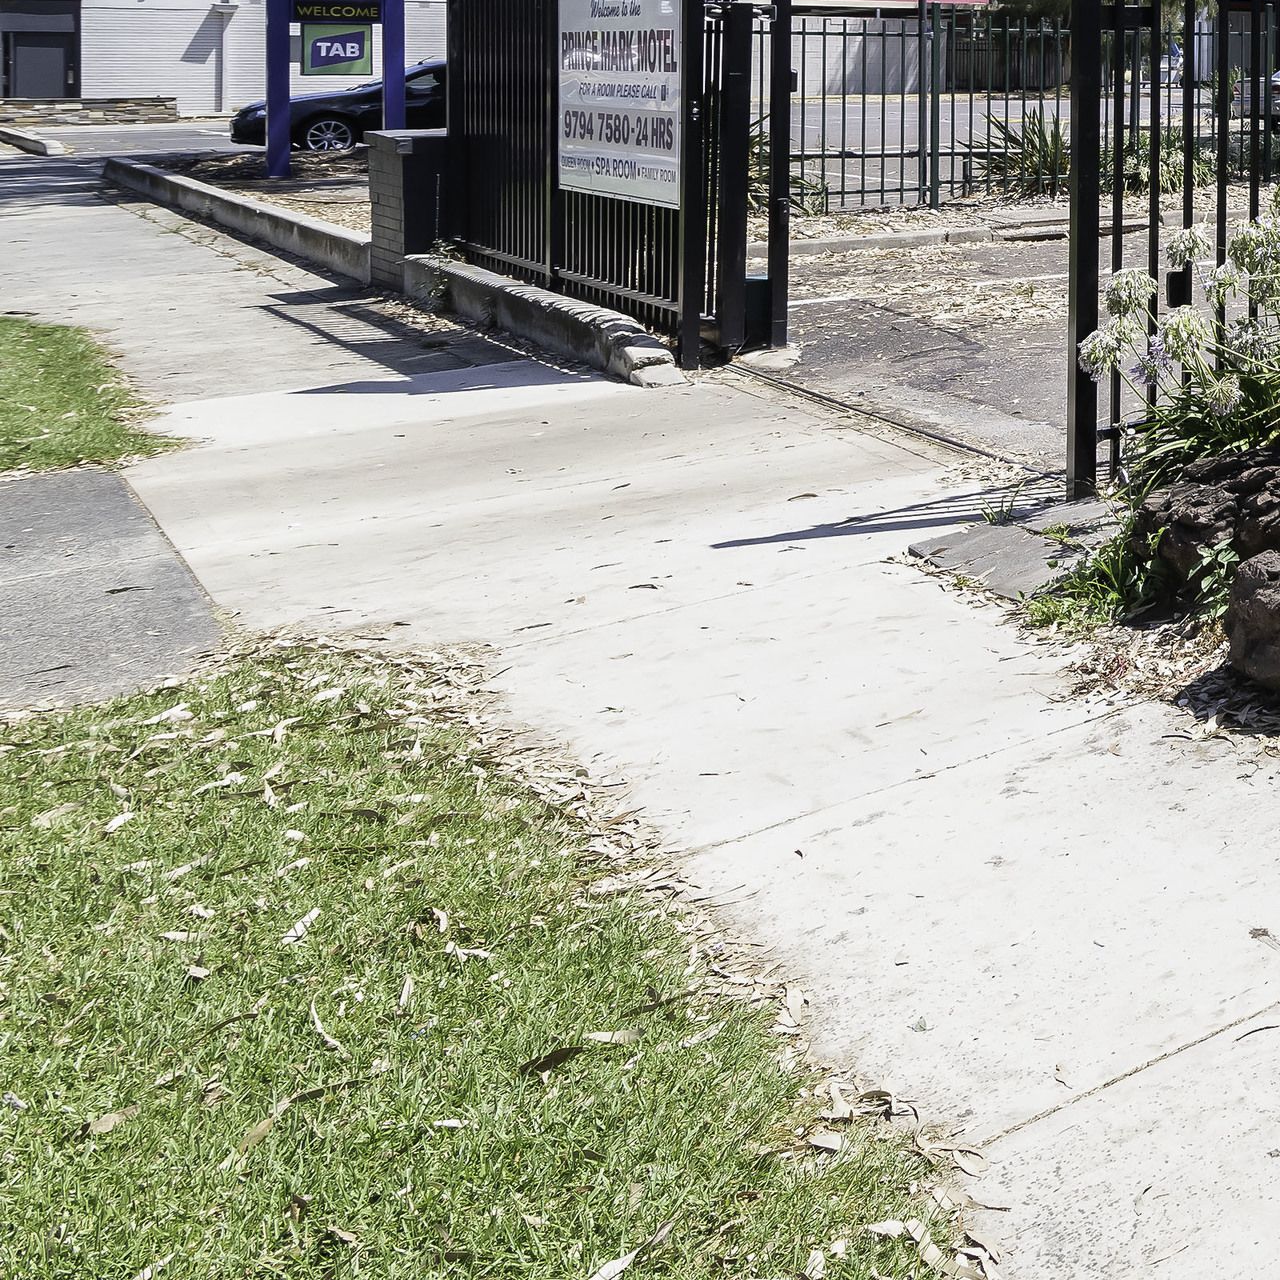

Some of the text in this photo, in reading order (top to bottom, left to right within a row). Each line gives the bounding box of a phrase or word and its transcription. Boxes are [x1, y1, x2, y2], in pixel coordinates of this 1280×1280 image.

[297, 6, 378, 17] WELCOME
[316, 42, 360, 57] TAB
[561, 29, 678, 73] PRINCE MARK MOTEL
[579, 82, 657, 99] FOR A ROOM PLEASE CALL
[564, 111, 594, 140] 9794
[652, 117, 674, 151] HRS
[595, 157, 611, 177] SPA
[612, 159, 637, 181] ROOM
[641, 167, 660, 181] FAMILY
[660, 169, 677, 184] ROOM
